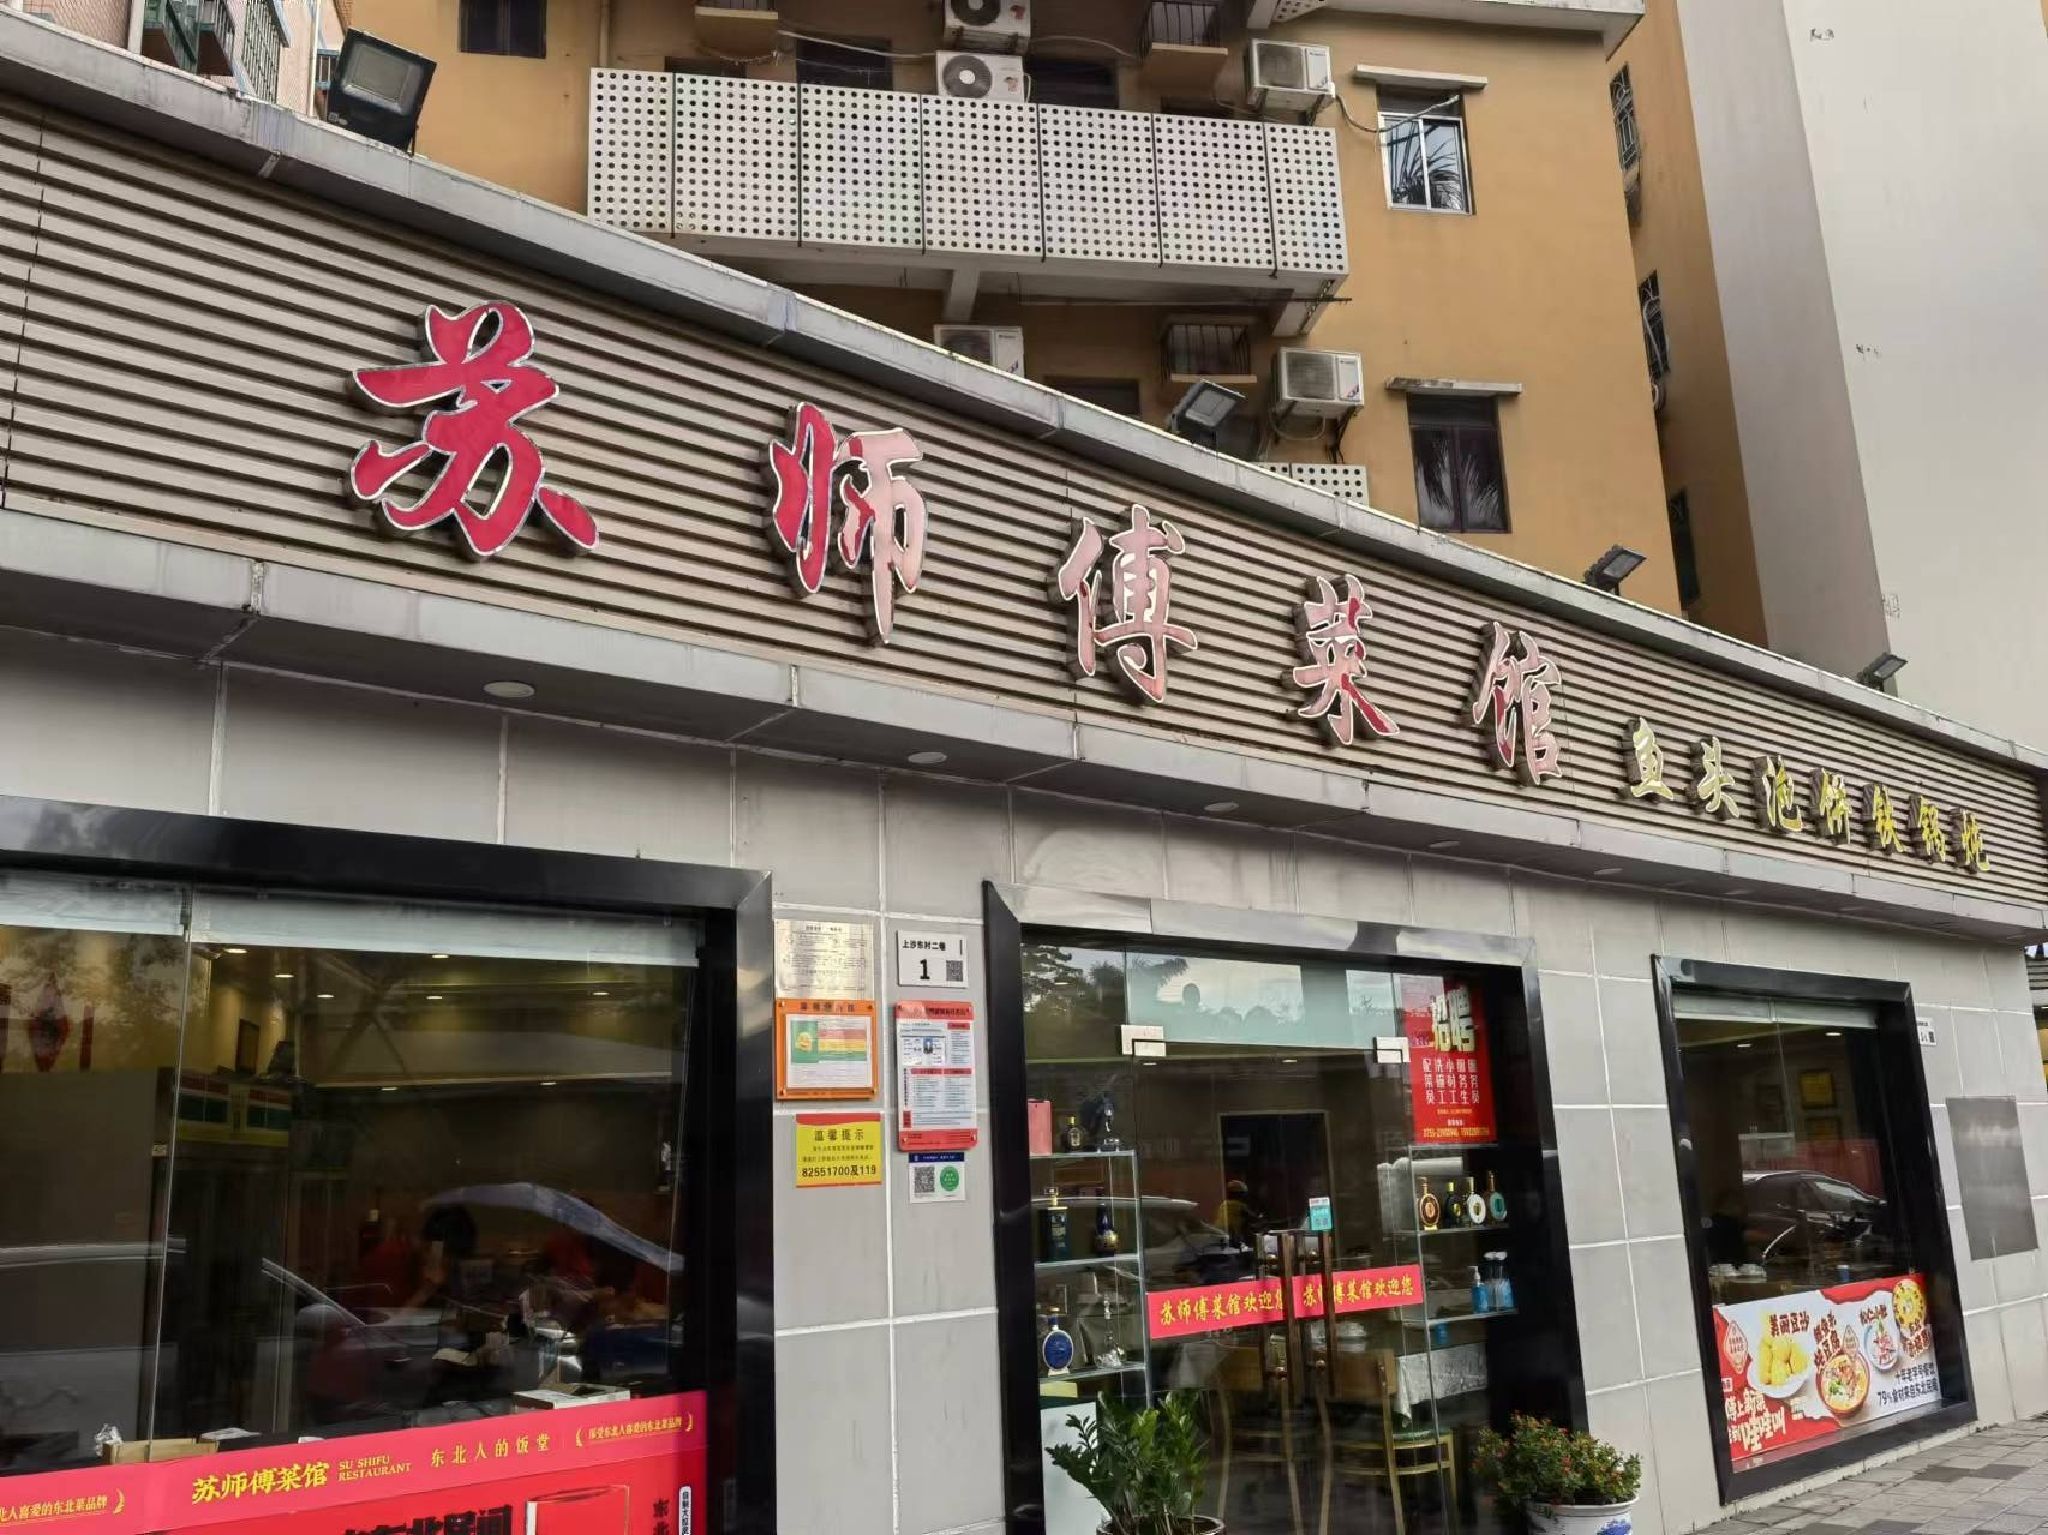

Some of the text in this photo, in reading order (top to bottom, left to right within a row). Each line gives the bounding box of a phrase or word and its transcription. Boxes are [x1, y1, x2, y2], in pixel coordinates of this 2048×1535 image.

[351, 302, 1563, 785] 苏师傅菜馆
[920, 959, 930, 979] 1
[338, 1456, 390, 1471] SU SHIFU
[431, 1434, 550, 1468] 东北人的饭堂
[191, 1461, 331, 1506] 苏师傅菜馆
[338, 1463, 412, 1482] RESTAURANT
